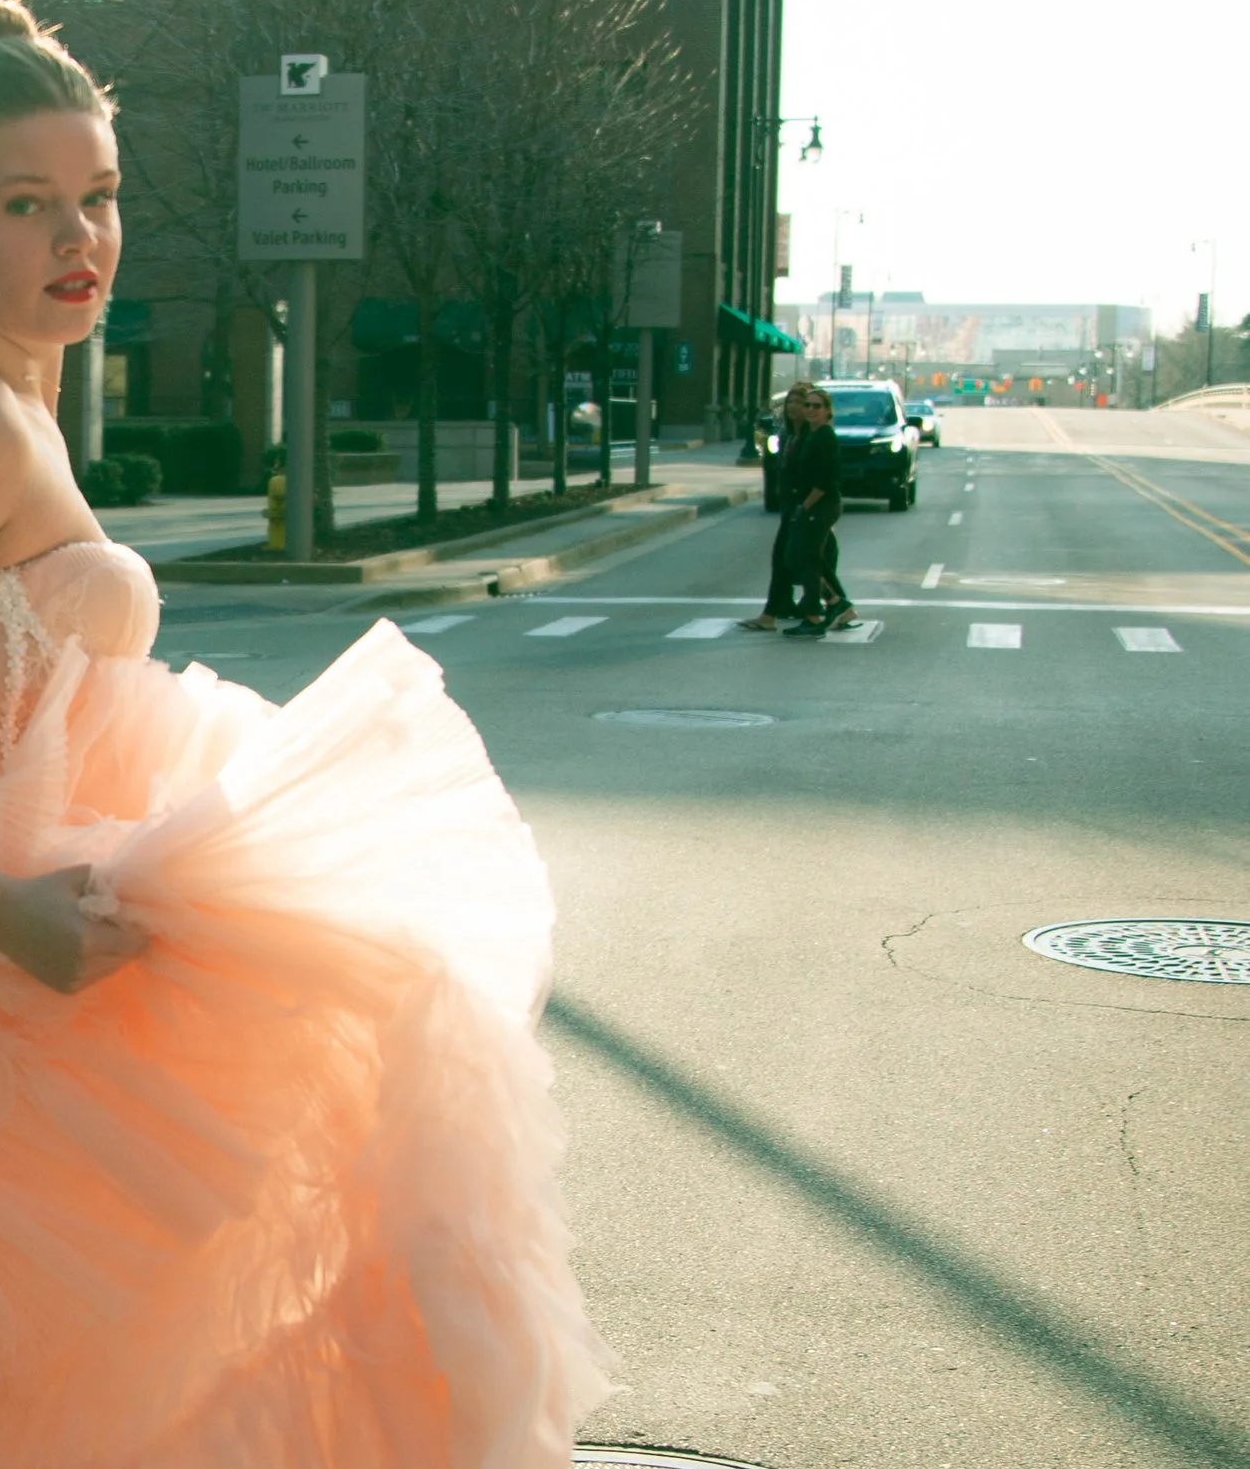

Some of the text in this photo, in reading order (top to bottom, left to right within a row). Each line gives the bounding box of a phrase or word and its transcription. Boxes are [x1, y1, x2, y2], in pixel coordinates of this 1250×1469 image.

[246, 155, 356, 172] Hotel/Ballroom
[273, 180, 327, 197] Parking
[252, 231, 347, 248] Valet Parking
